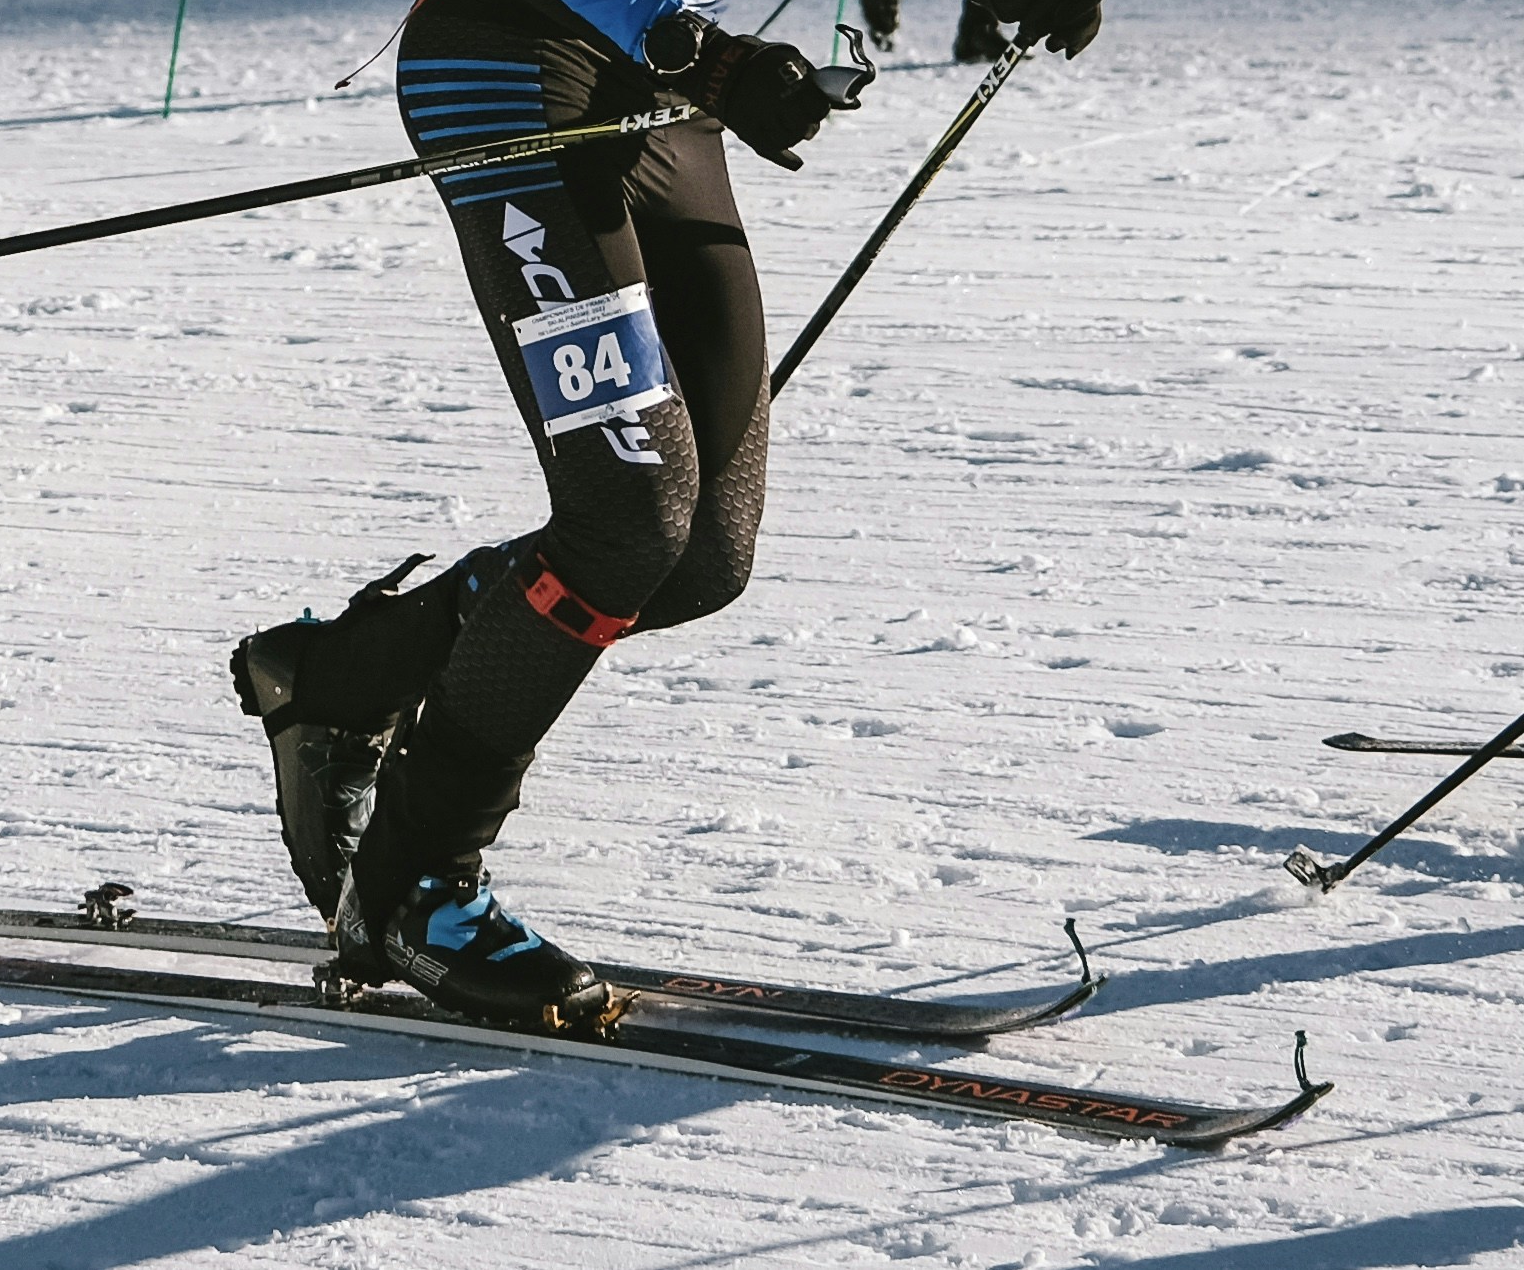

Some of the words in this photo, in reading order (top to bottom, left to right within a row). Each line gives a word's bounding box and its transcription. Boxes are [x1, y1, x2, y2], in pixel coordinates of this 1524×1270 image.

[977, 42, 1022, 104] LEKI
[620, 103, 691, 133] LEKI
[553, 331, 632, 402] 84
[879, 1071, 1188, 1128] DYNASTAR
